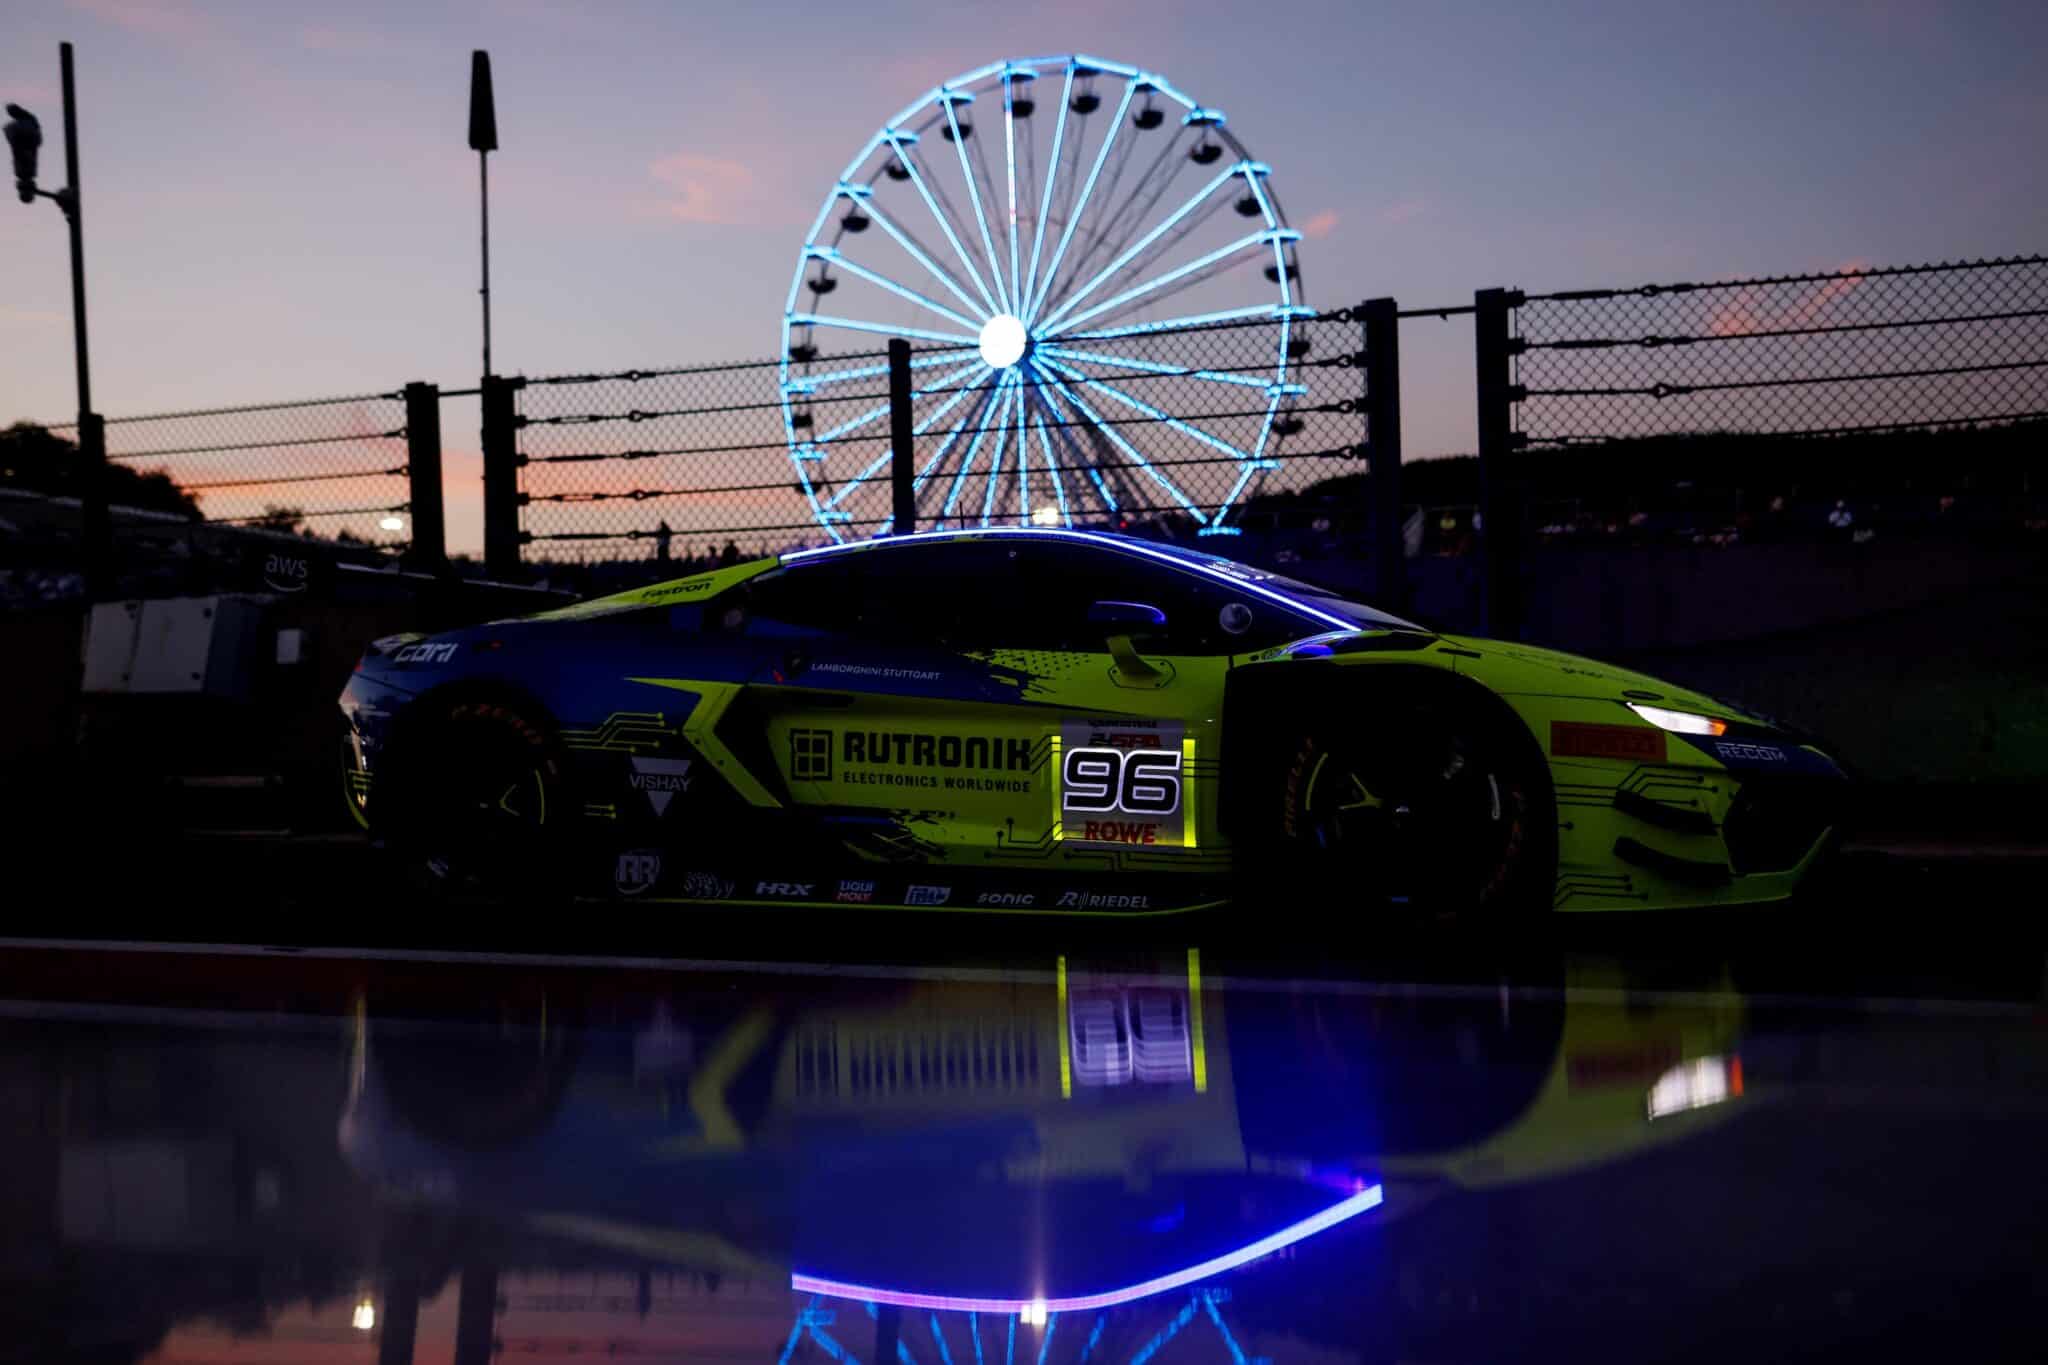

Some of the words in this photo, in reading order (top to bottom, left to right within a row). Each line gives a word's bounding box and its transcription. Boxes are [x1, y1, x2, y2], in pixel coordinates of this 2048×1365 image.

[264, 552, 309, 579] aws
[845, 731, 1031, 771] RUTRONIK
[1715, 742, 1789, 763] RECOM
[630, 775, 691, 792] VISHAY
[843, 771, 937, 786] ELECTRONICS
[944, 777, 1030, 794] WORLDWIDE
[1063, 747, 1182, 815] 96
[1085, 821, 1157, 843] ROWE
[754, 881, 815, 897] HRX
[839, 880, 874, 892] LIQUI
[1087, 895, 1151, 909] RIEDEL
